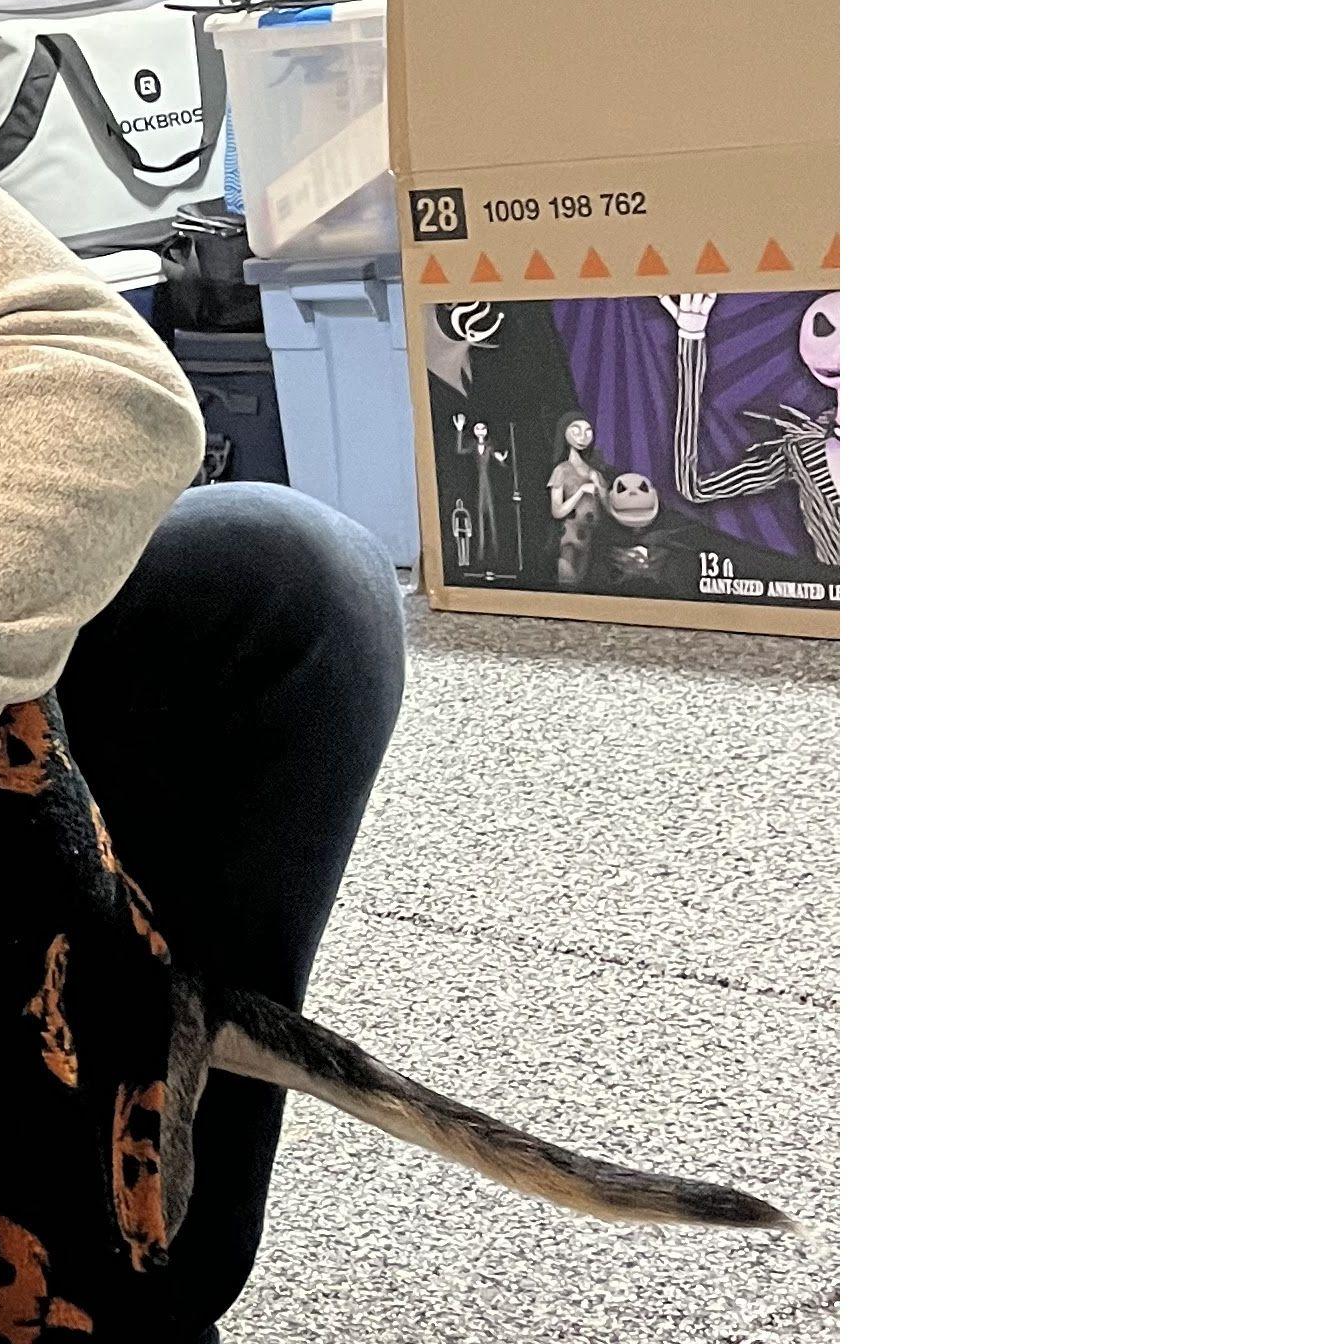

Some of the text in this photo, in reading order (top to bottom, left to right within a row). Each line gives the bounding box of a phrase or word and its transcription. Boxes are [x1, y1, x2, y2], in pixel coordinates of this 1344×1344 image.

[106, 107, 203, 136] OCKBROS
[416, 196, 459, 233] 28
[483, 191, 648, 223] 1009 198 762
[699, 552, 720, 577] 13
[767, 581, 826, 600] ANIMATED
